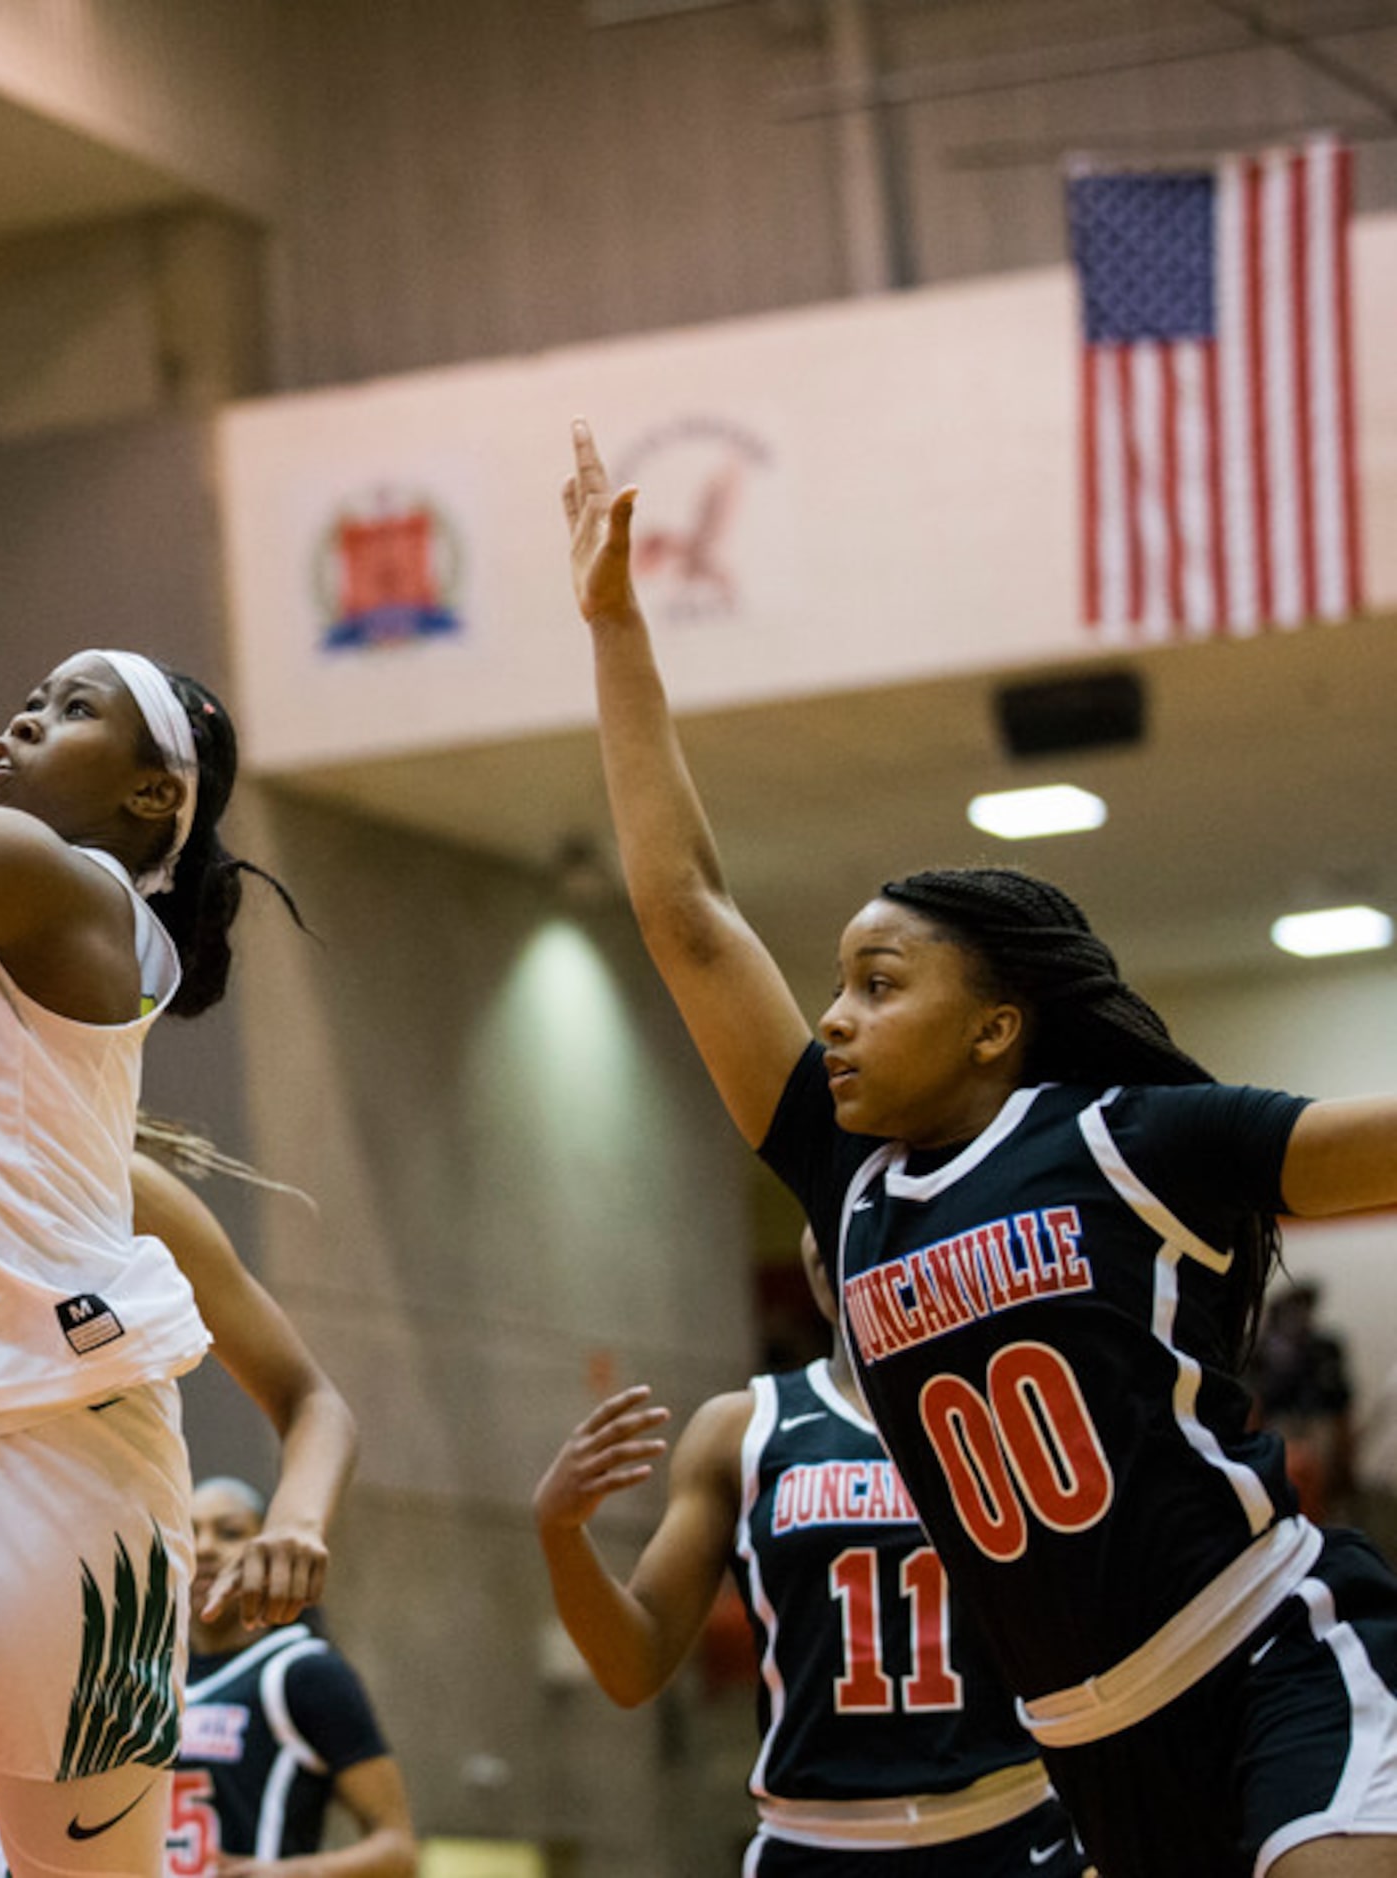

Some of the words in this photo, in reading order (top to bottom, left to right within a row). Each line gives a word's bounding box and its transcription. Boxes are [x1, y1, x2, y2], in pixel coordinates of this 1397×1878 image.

[67, 1298, 94, 1323] M
[772, 1459, 921, 1537] DUNCAN
[920, 1341, 1113, 1562] 00
[828, 1546, 963, 1714] 11
